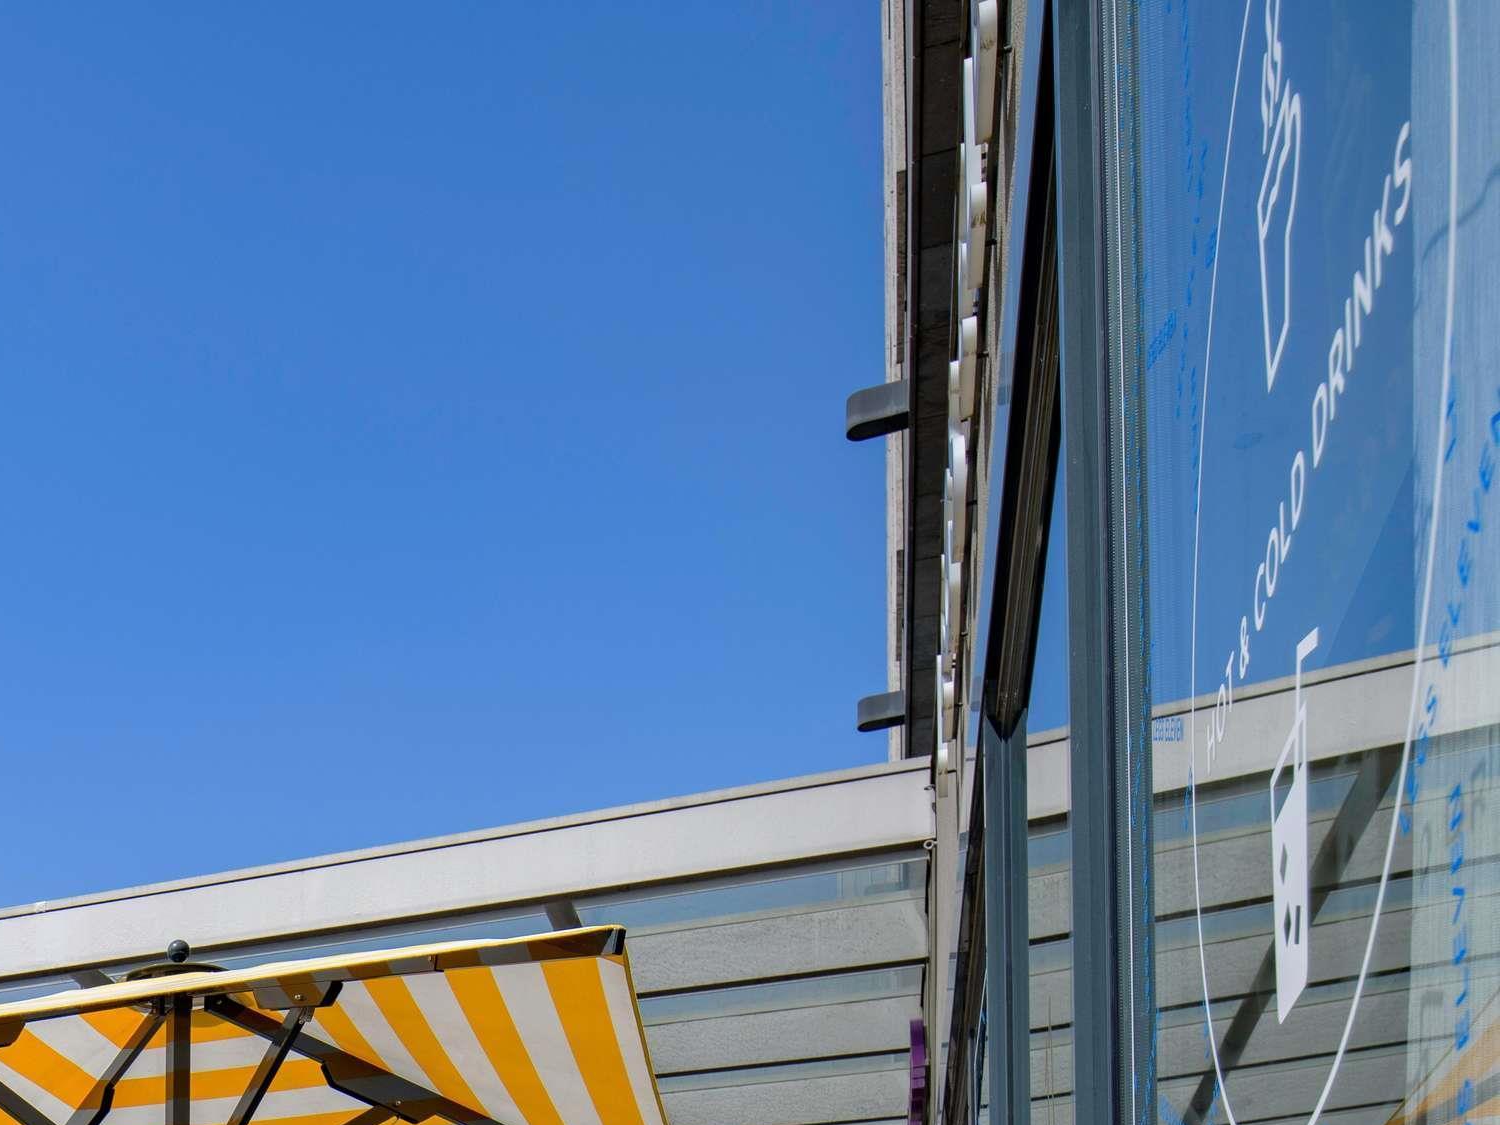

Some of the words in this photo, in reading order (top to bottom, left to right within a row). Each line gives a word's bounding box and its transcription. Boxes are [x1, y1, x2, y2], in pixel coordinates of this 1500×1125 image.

[1205, 650, 1237, 776] HOT
[1239, 616, 1251, 680] &
[1254, 449, 1306, 632] COLD
[1311, 119, 1413, 470] DRINKS
